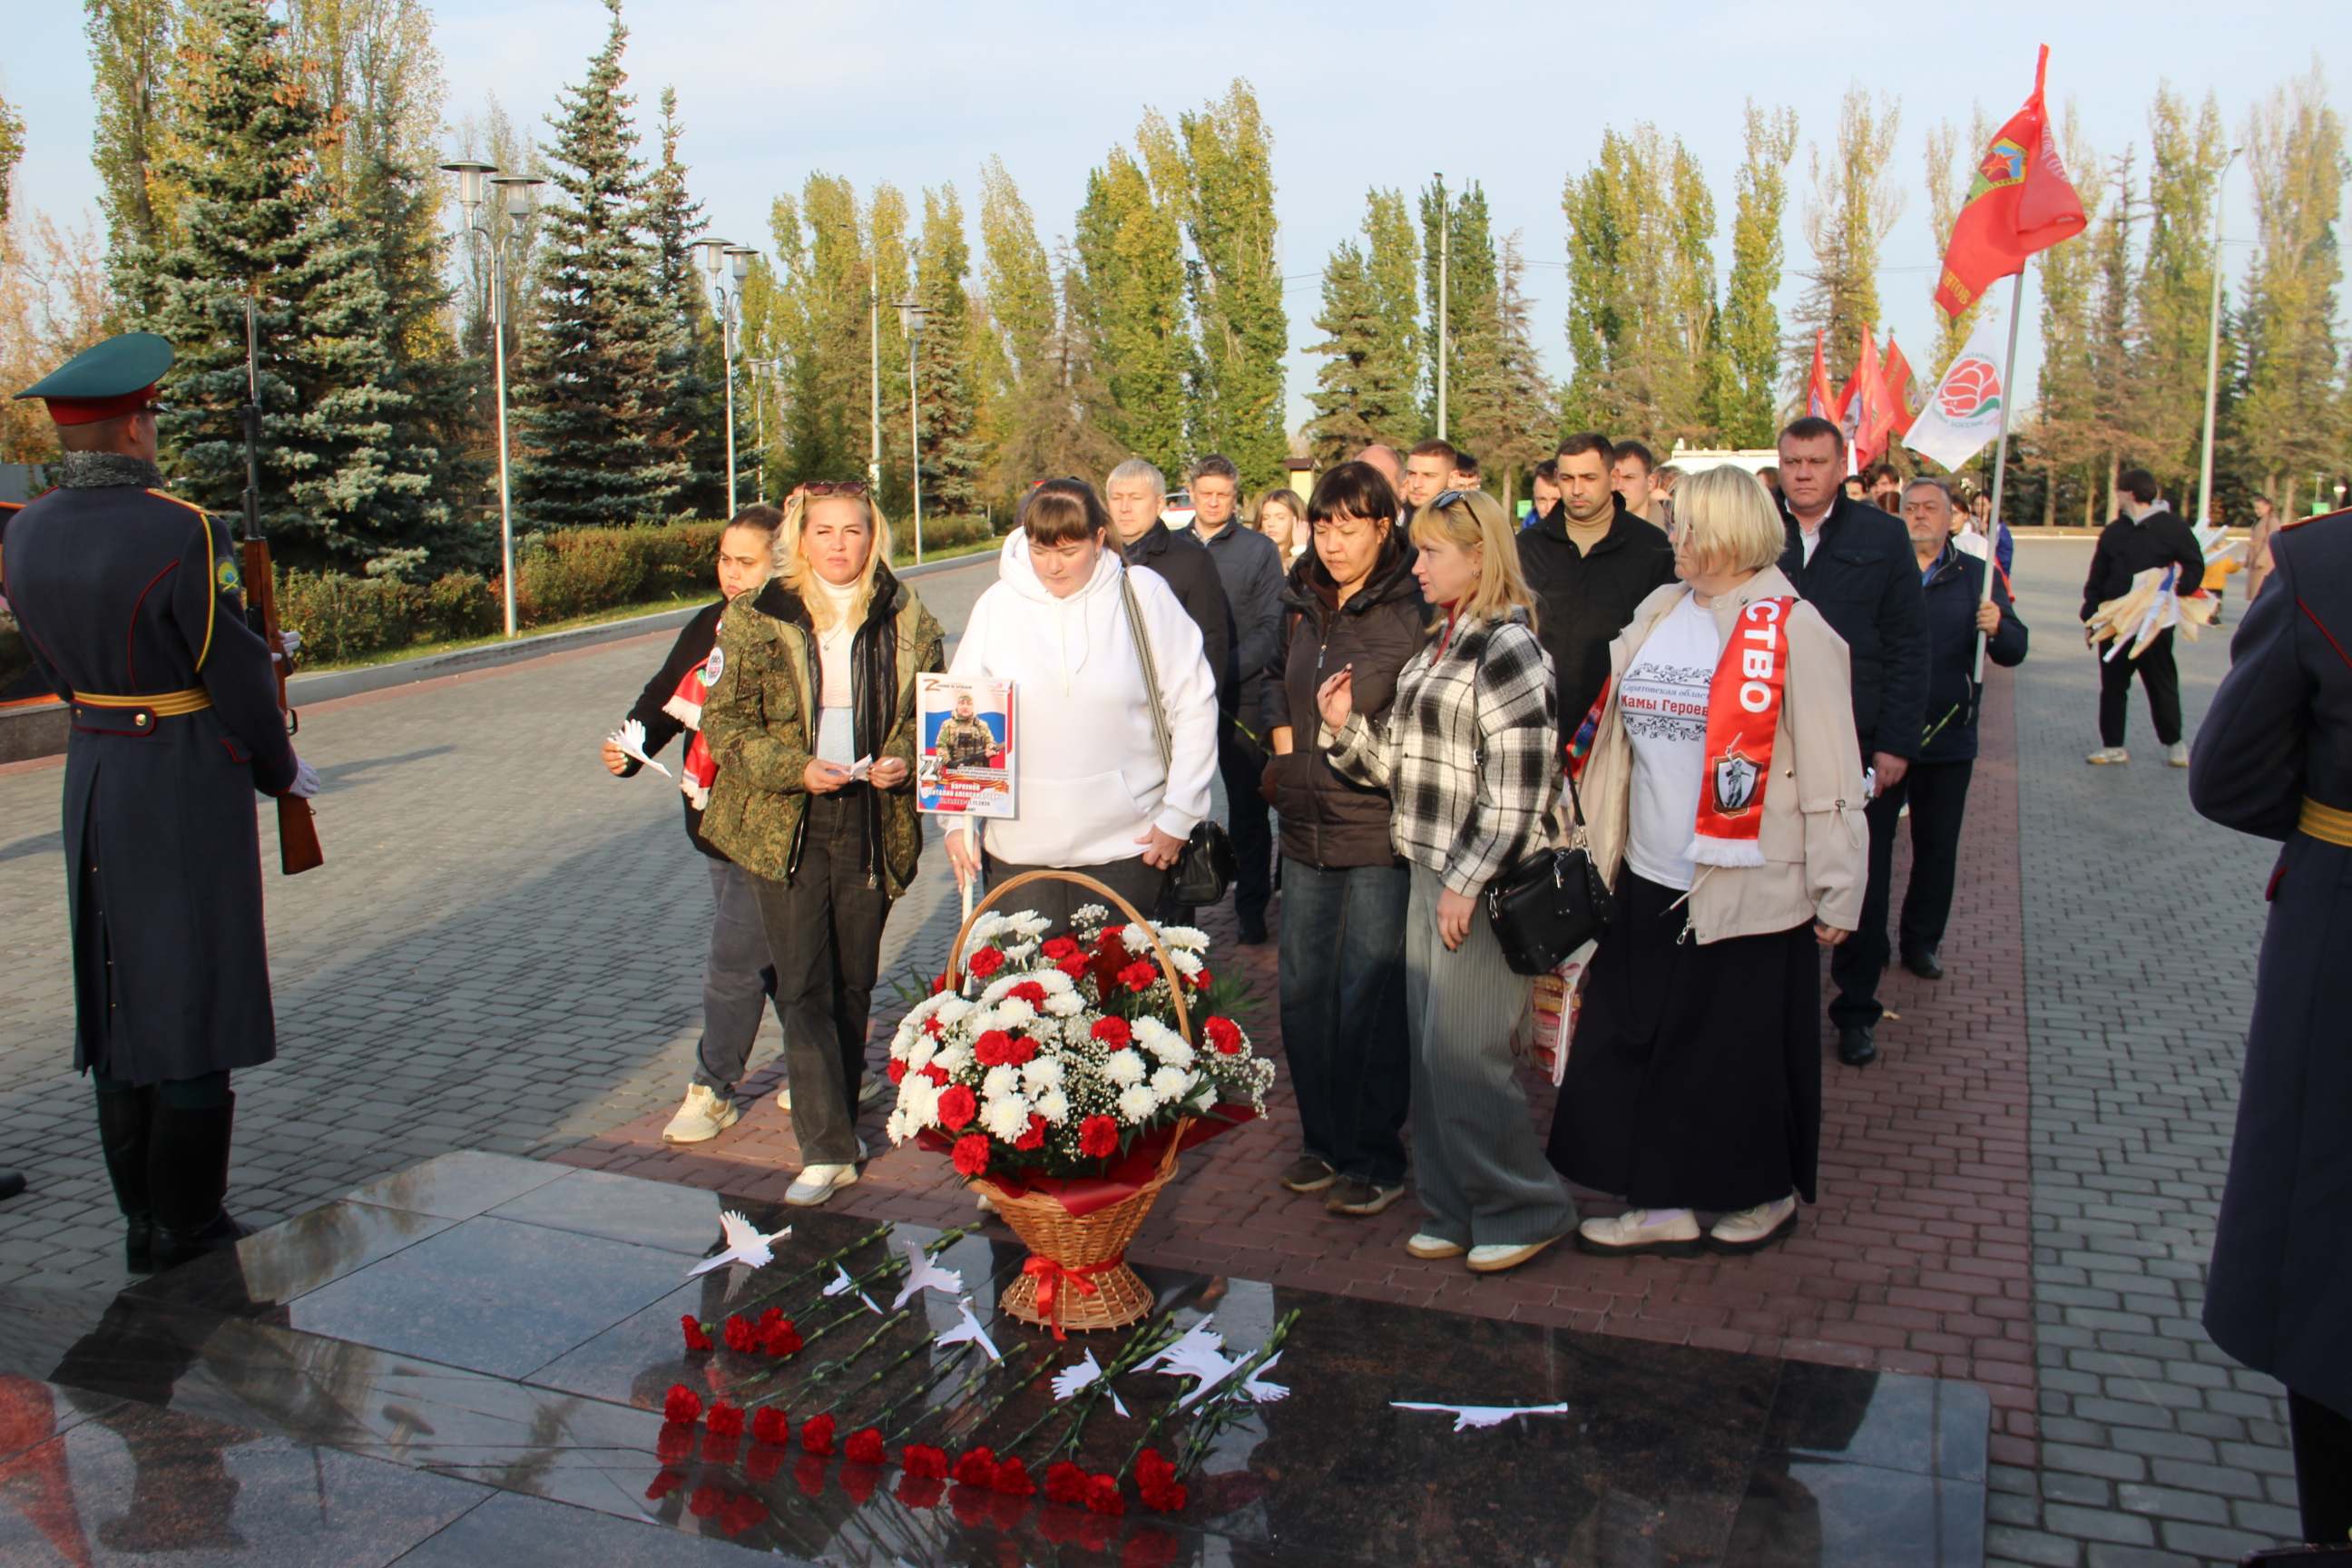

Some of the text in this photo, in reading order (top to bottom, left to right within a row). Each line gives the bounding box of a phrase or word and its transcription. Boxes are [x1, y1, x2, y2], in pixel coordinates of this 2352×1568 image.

[1740, 595, 1780, 713] СТВО
[1679, 689, 1708, 698] облас
[1661, 700, 1709, 716] Героев
